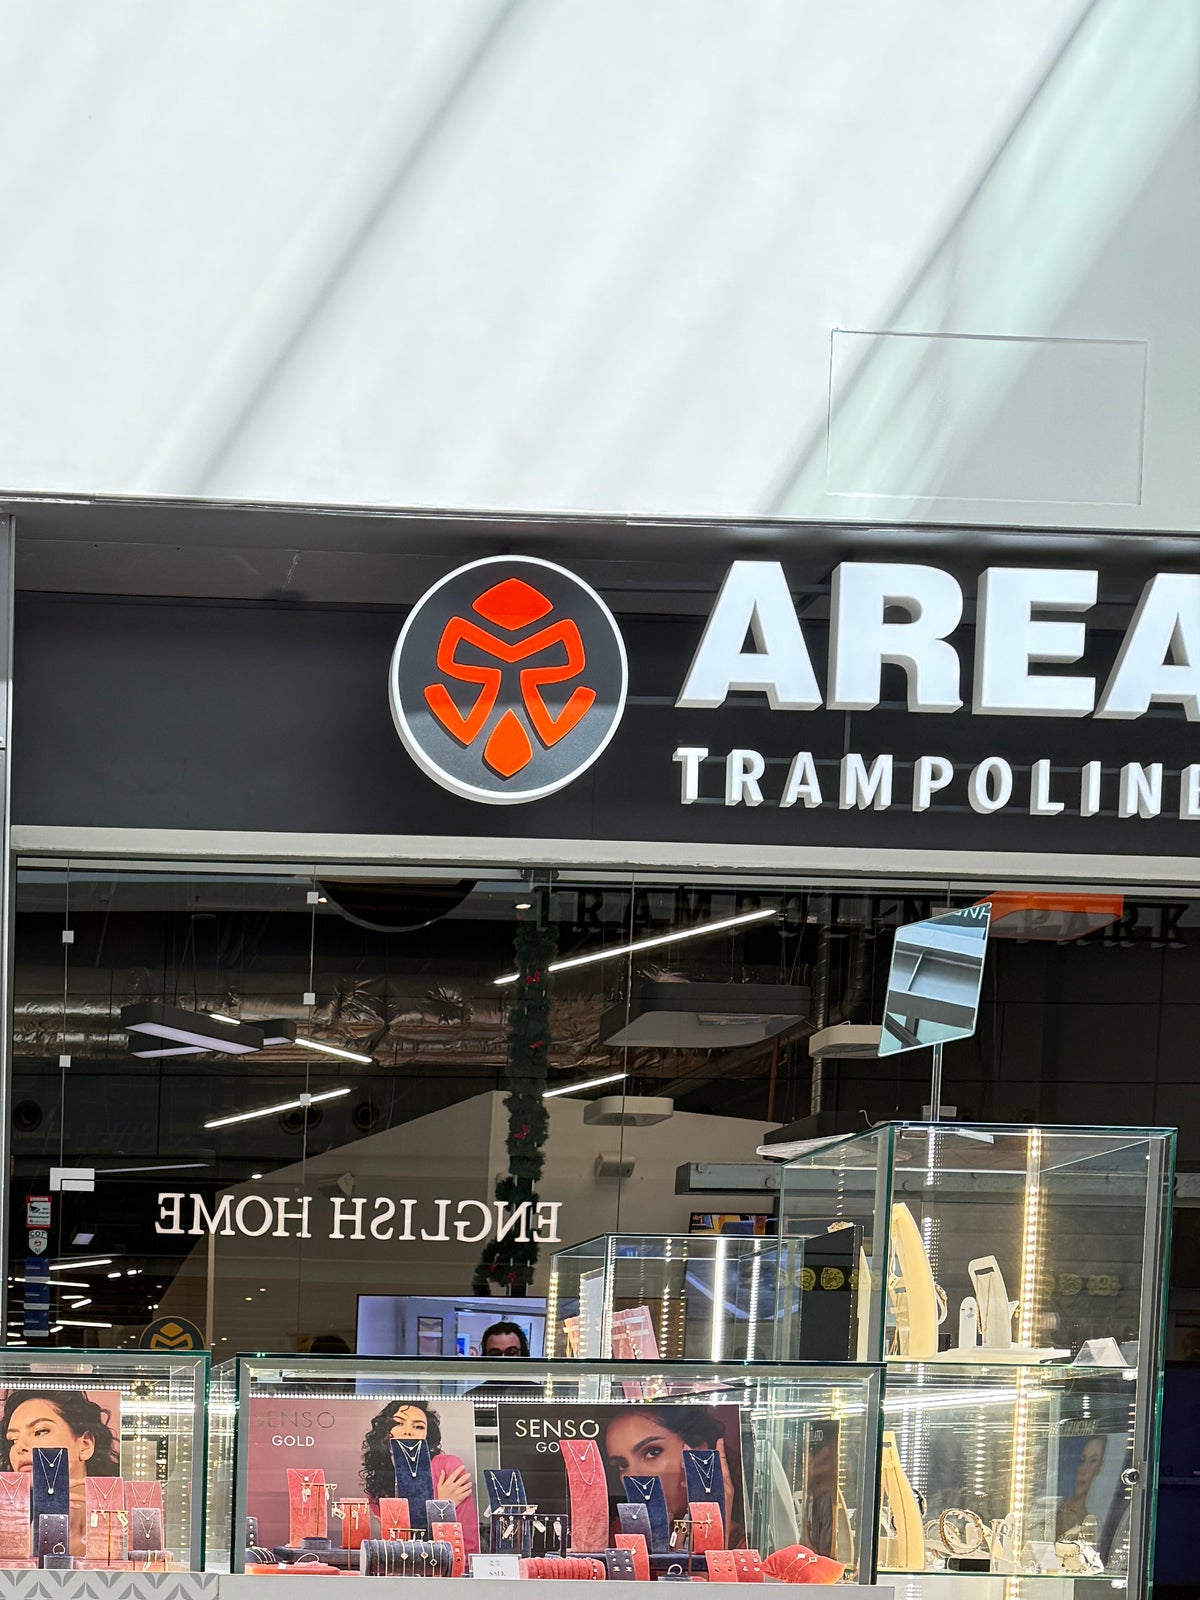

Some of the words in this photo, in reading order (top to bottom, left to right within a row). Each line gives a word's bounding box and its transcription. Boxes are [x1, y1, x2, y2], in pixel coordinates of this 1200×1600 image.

[674, 560, 1200, 722] AREA
[514, 1418, 601, 1438] SENSO
[271, 1434, 315, 1447] GOLD
[535, 1441, 560, 1453] GO
